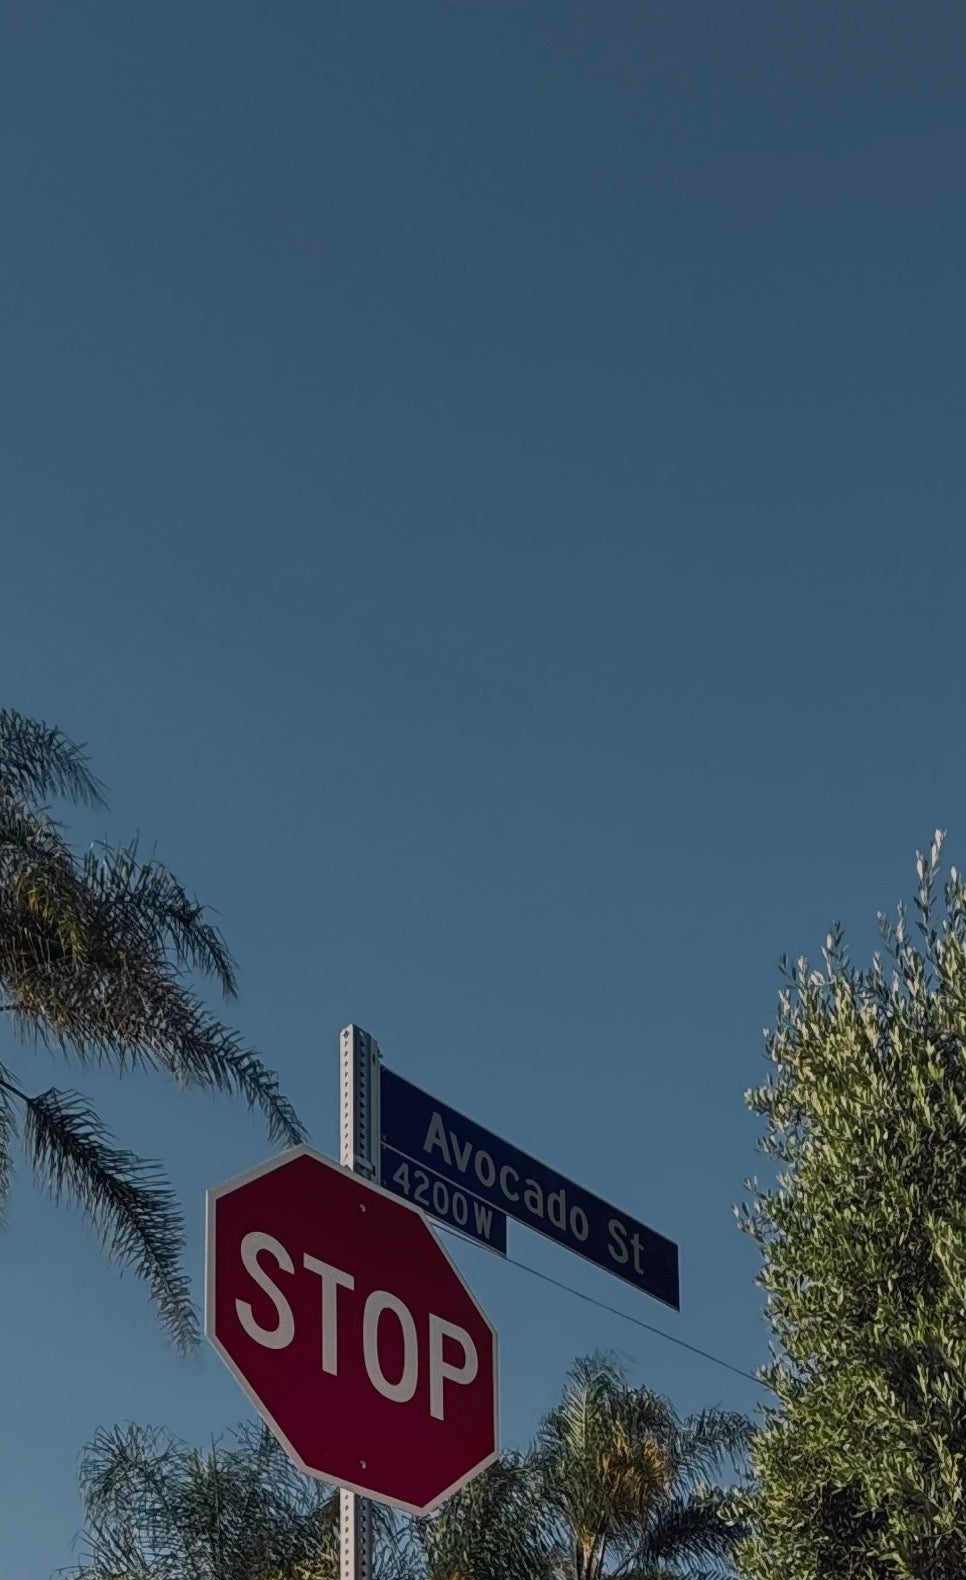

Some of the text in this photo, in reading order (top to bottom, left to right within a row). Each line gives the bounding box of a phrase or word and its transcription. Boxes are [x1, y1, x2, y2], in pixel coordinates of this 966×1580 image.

[423, 1111, 645, 1275] Avocado St
[234, 1230, 479, 1422] STOP
